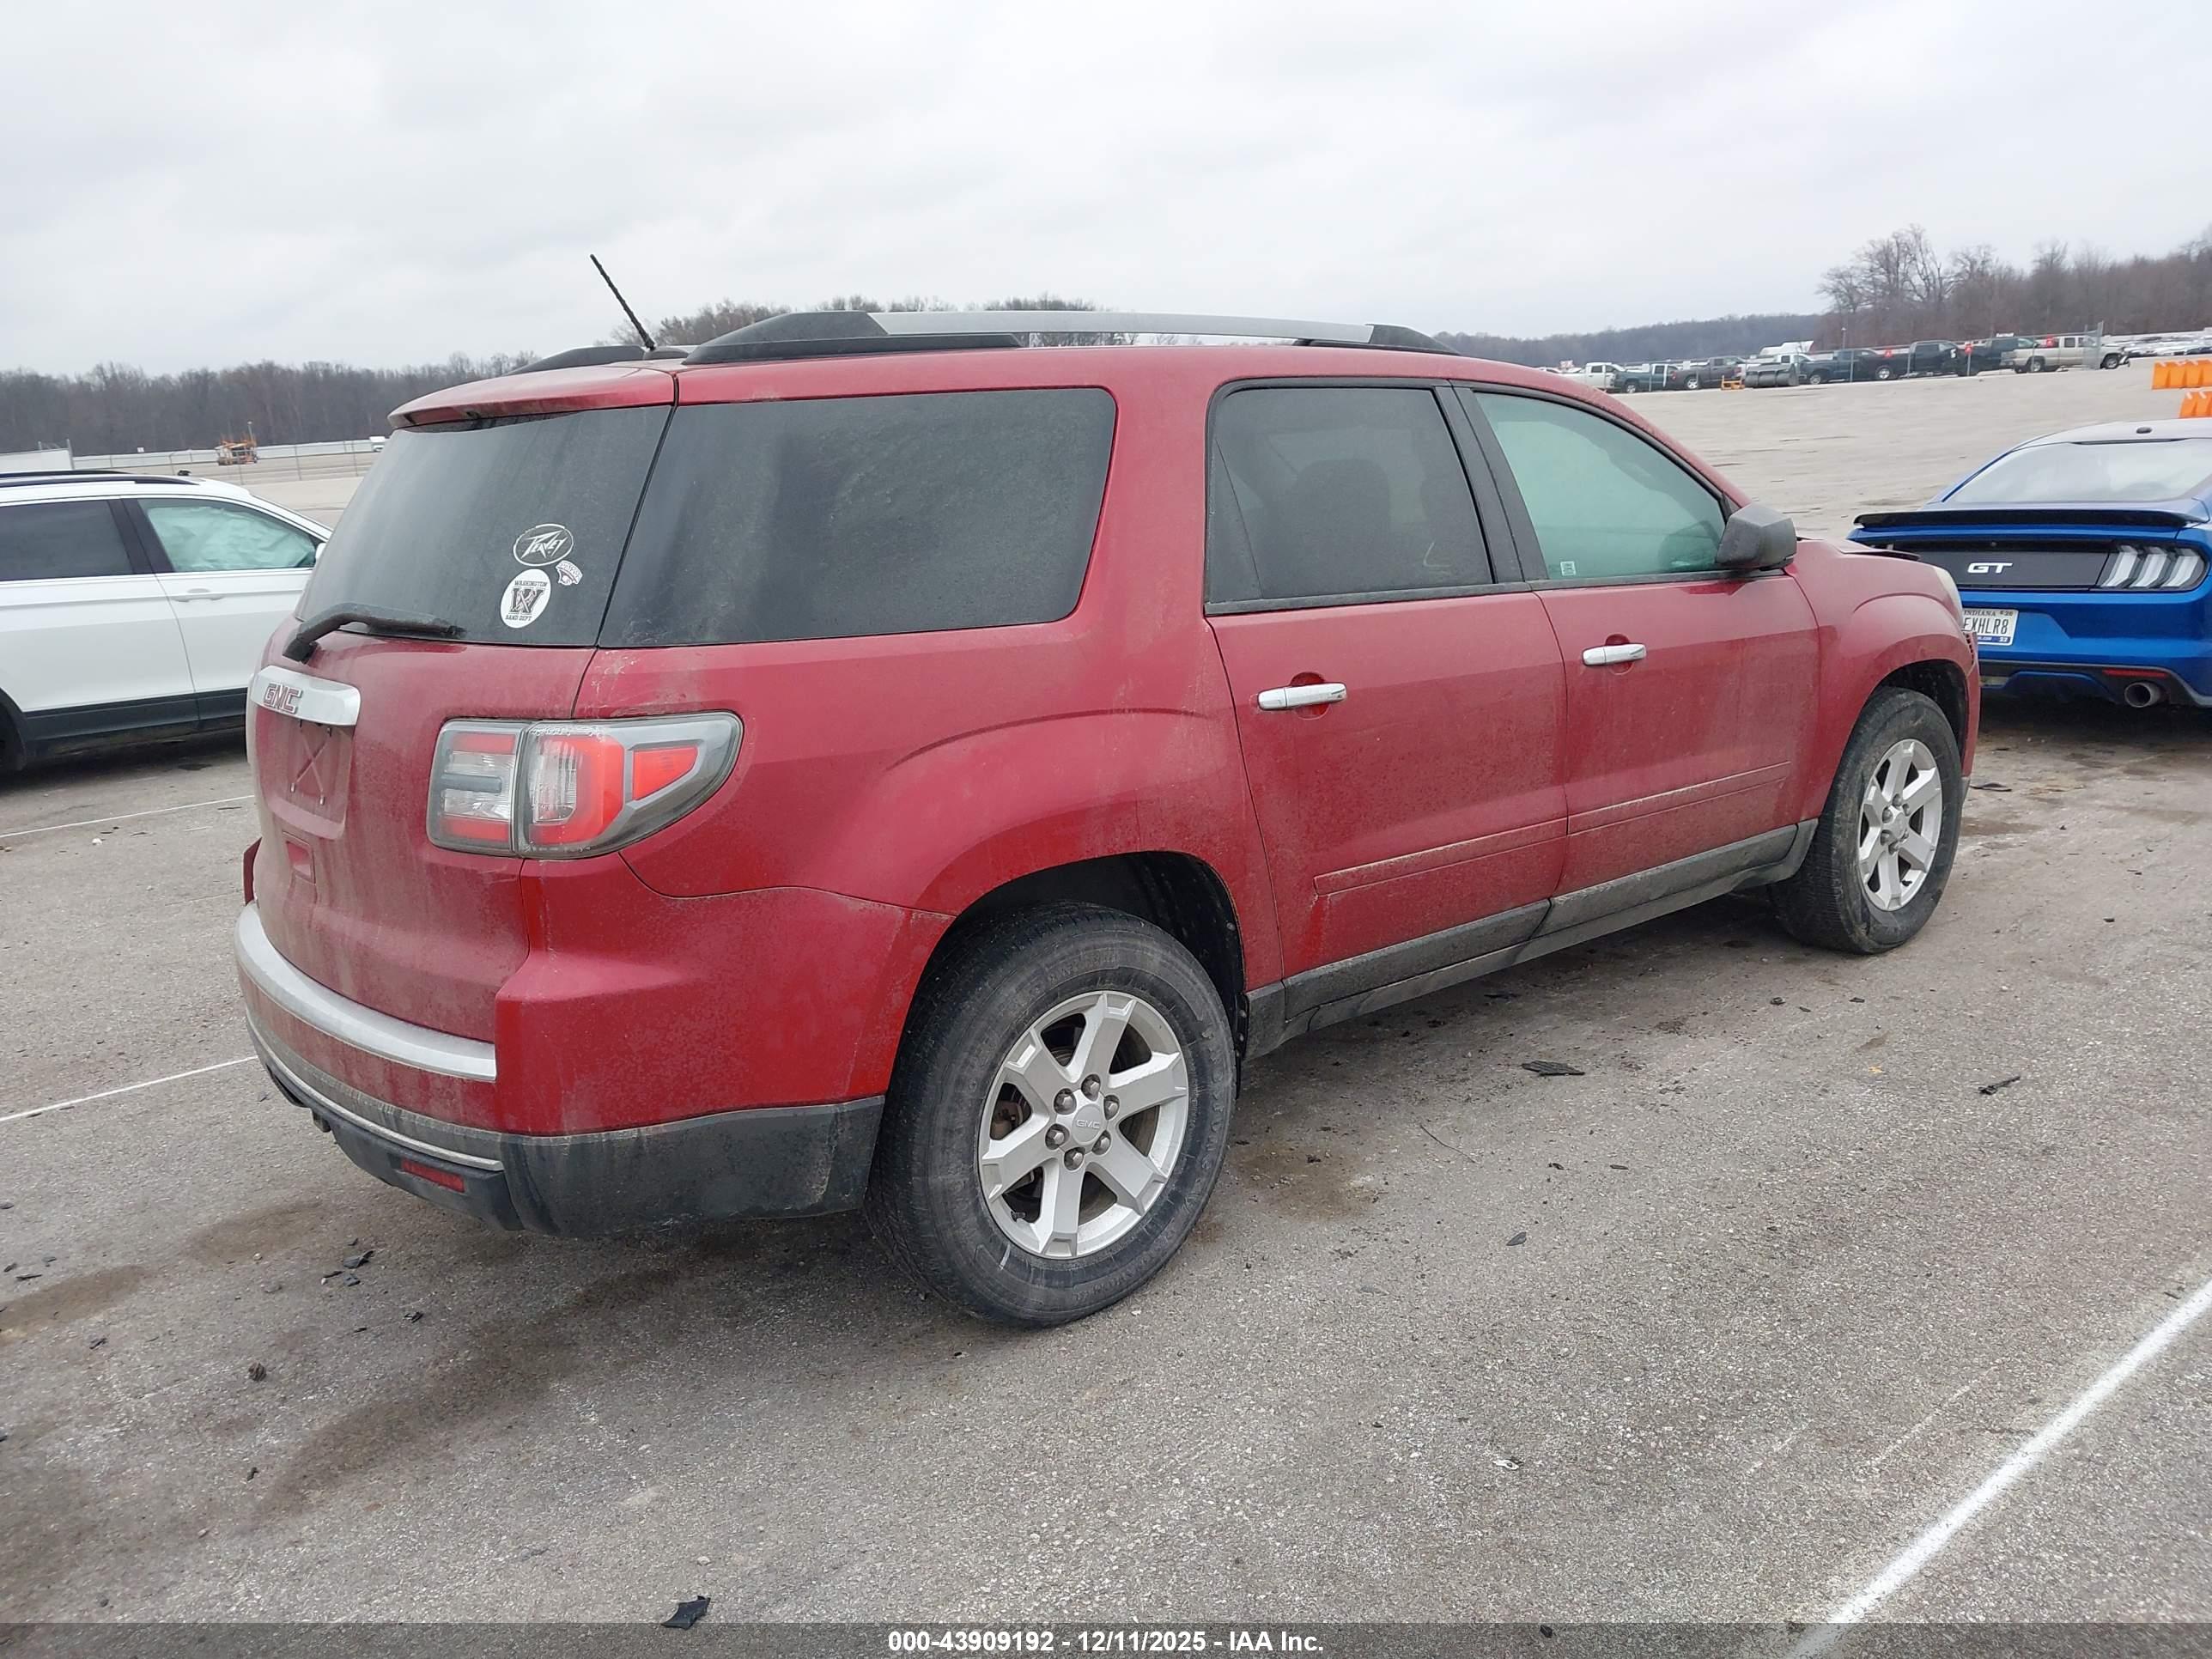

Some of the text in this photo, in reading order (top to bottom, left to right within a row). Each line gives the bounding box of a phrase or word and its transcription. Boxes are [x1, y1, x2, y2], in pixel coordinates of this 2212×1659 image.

[1967, 562, 2014, 574] GT
[264, 682, 304, 714] GMC
[1076, 1119, 1100, 1129] GMC
